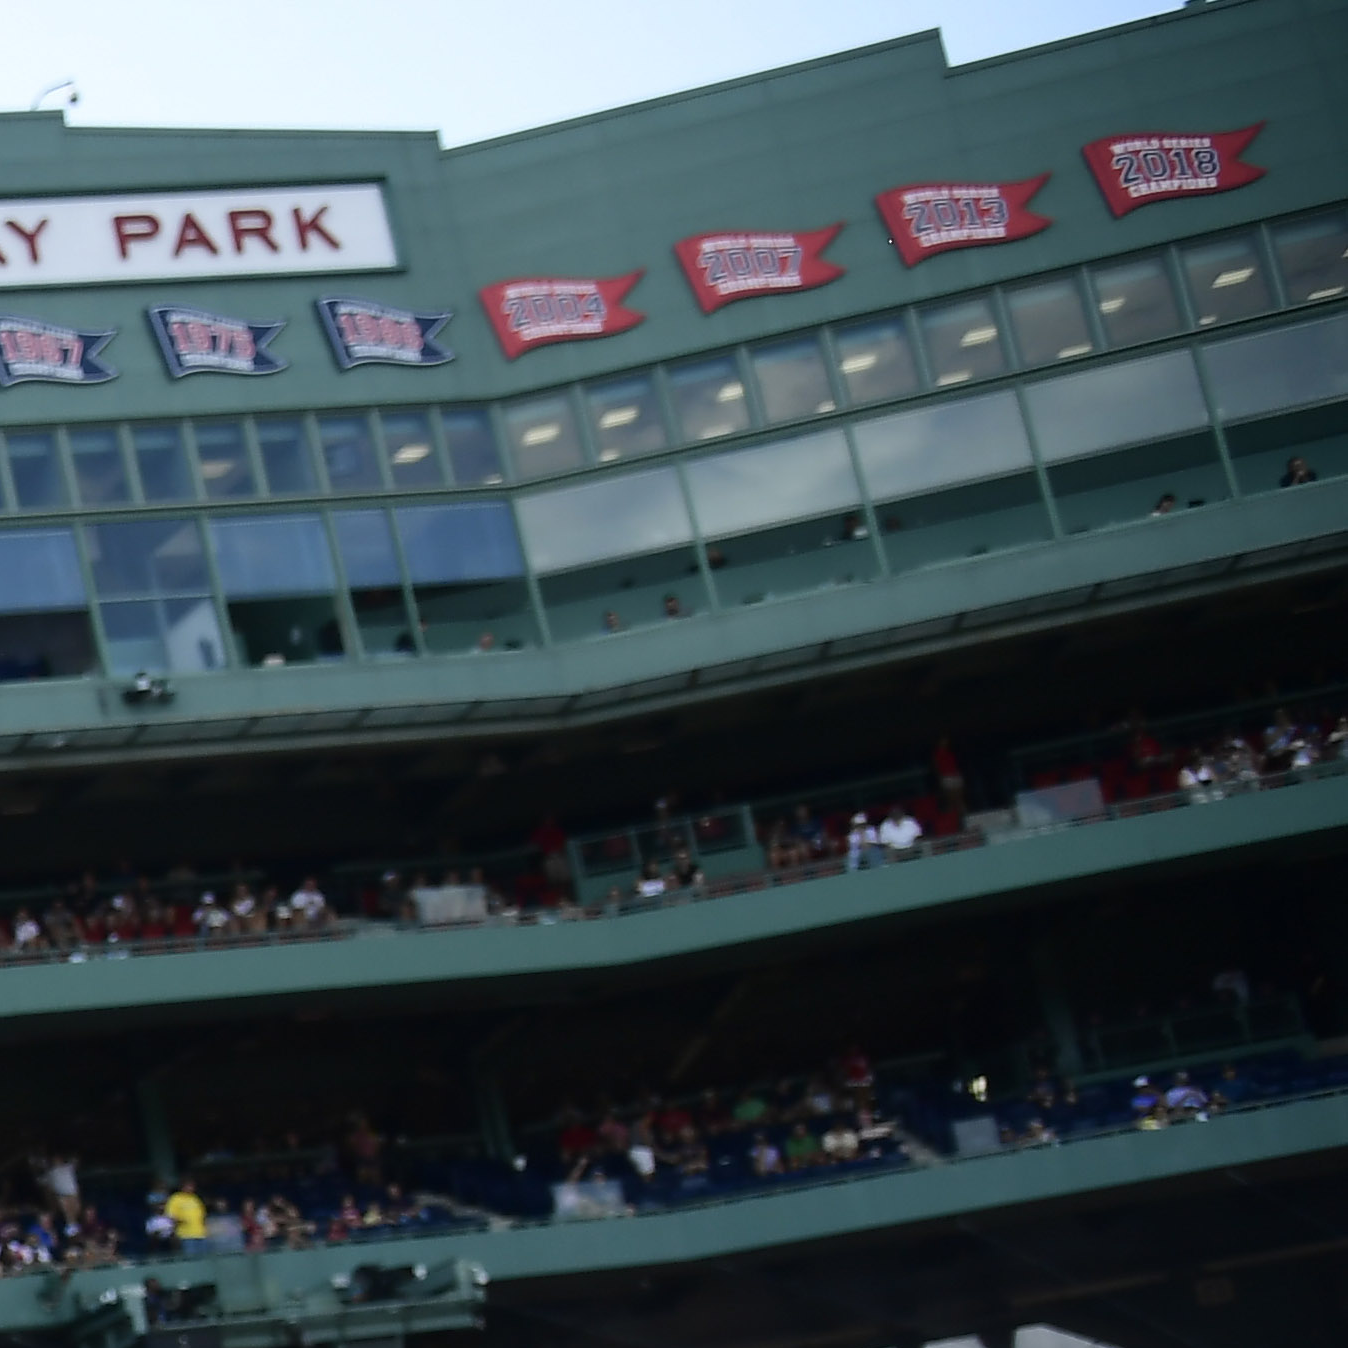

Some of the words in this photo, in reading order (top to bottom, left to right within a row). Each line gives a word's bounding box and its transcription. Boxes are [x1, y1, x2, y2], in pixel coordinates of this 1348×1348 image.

[1112, 146, 1220, 188] 2018
[112, 205, 342, 259] PARK
[905, 196, 1007, 236] 2013
[698, 247, 803, 285] 2007
[503, 293, 608, 331] 2004
